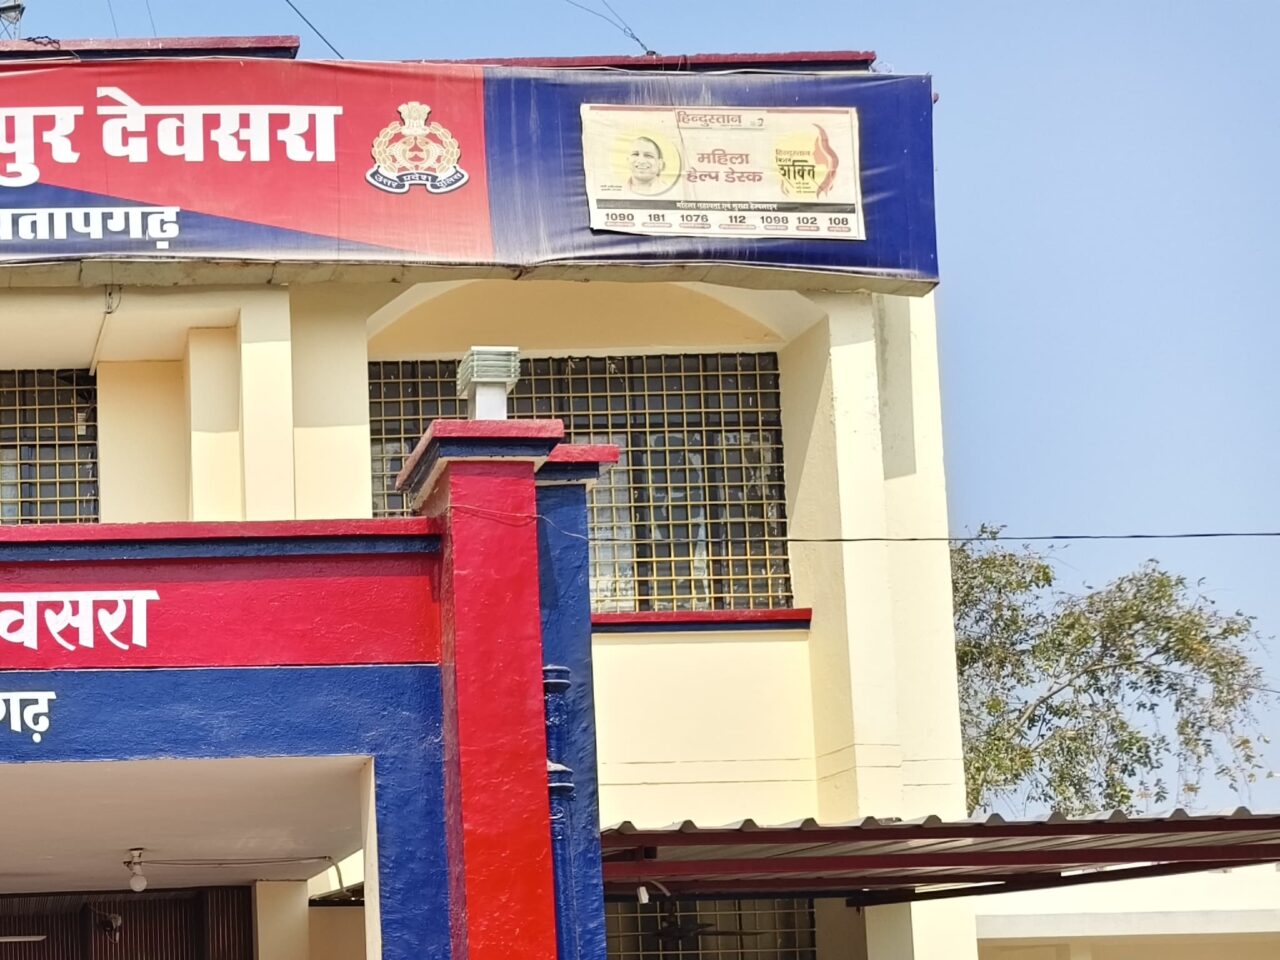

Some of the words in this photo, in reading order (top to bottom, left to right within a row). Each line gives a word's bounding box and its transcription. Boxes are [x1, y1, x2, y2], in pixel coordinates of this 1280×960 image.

[98, 86, 342, 164] देवसरा
[697, 148, 750, 165] महिला
[686, 167, 720, 183] हेल्प
[723, 167, 764, 183] डेस्क
[778, 159, 816, 180] शक्ति
[605, 212, 634, 222] 1090
[648, 213, 666, 222] 181
[680, 214, 709, 223] 1076
[728, 215, 747, 224] 112
[760, 216, 789, 224] 1098
[797, 216, 818, 225] 102
[828, 217, 849, 226] 108
